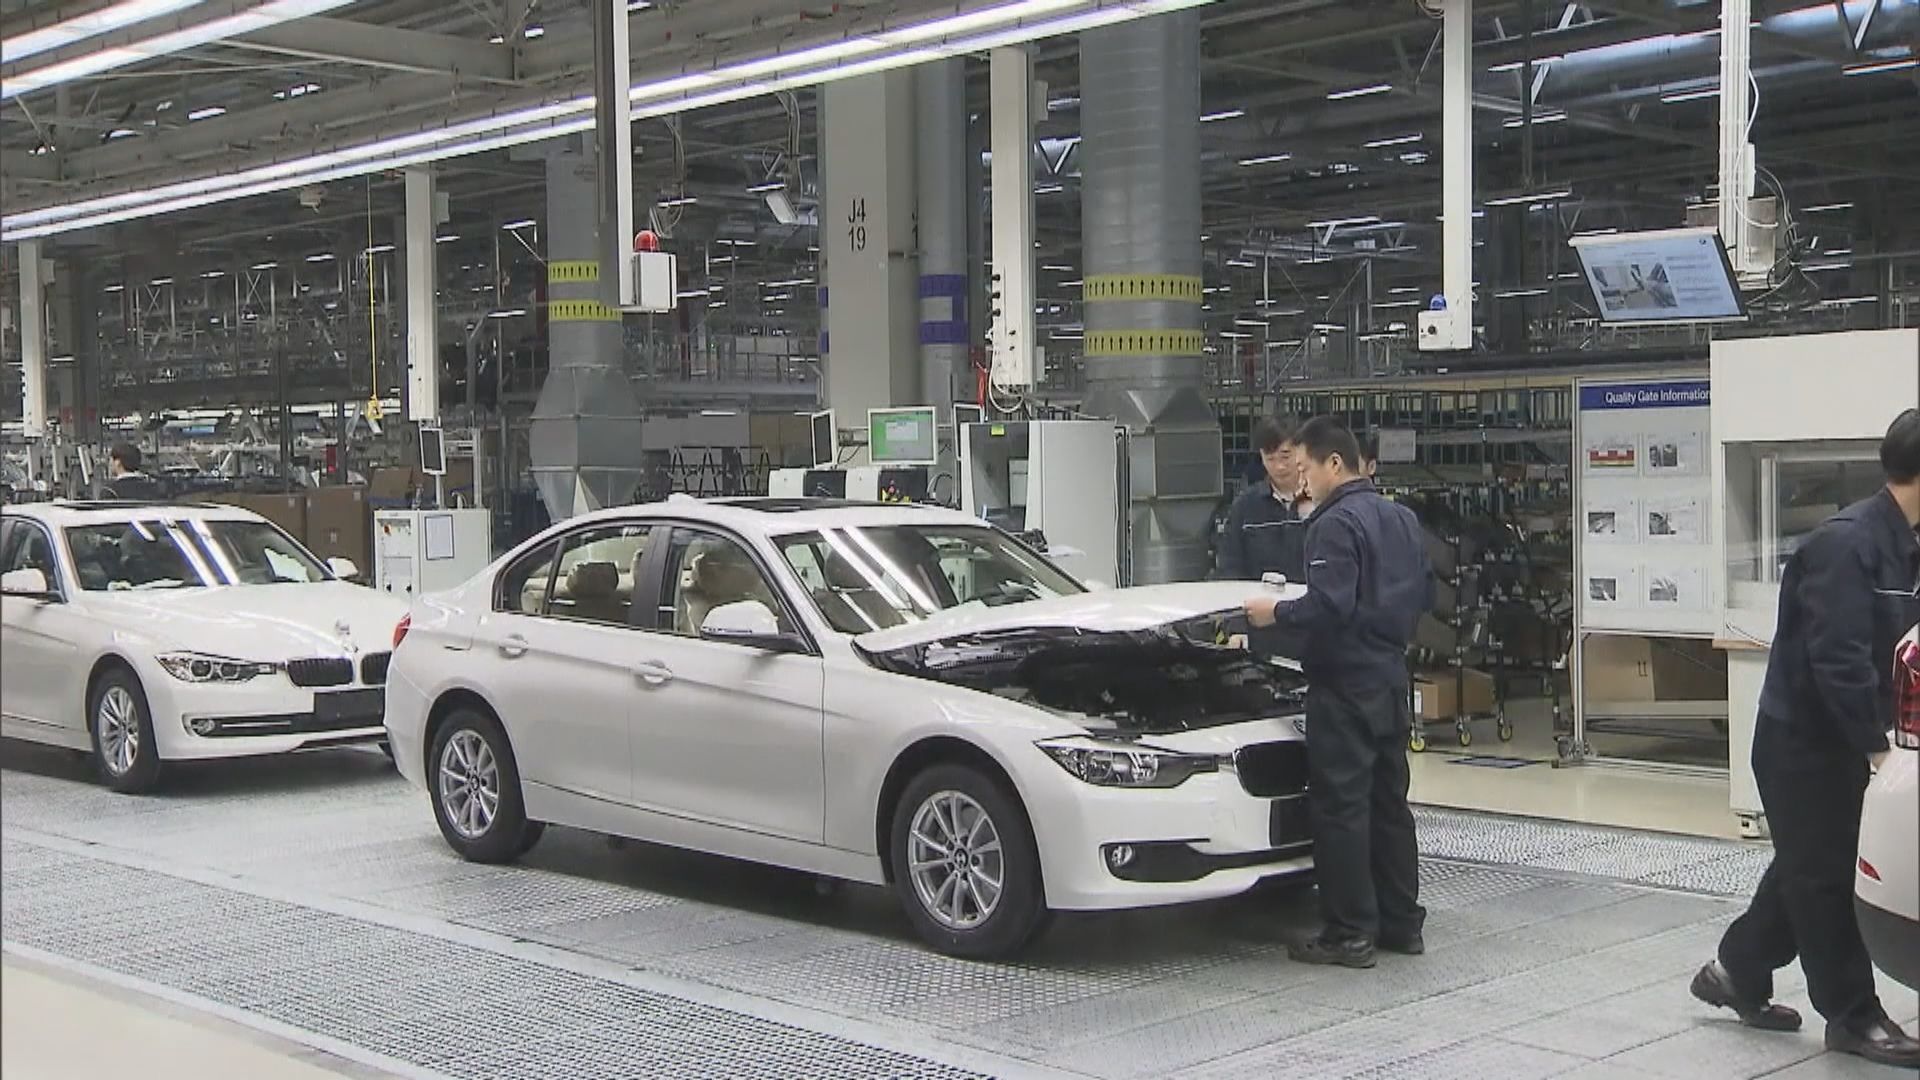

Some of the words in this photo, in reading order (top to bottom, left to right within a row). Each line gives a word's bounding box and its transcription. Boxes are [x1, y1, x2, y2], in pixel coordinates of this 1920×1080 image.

[848, 198, 866, 223] J4
[848, 226, 866, 251] 19
[1605, 392, 1636, 404] Quality
[1637, 390, 1659, 401] Gate
